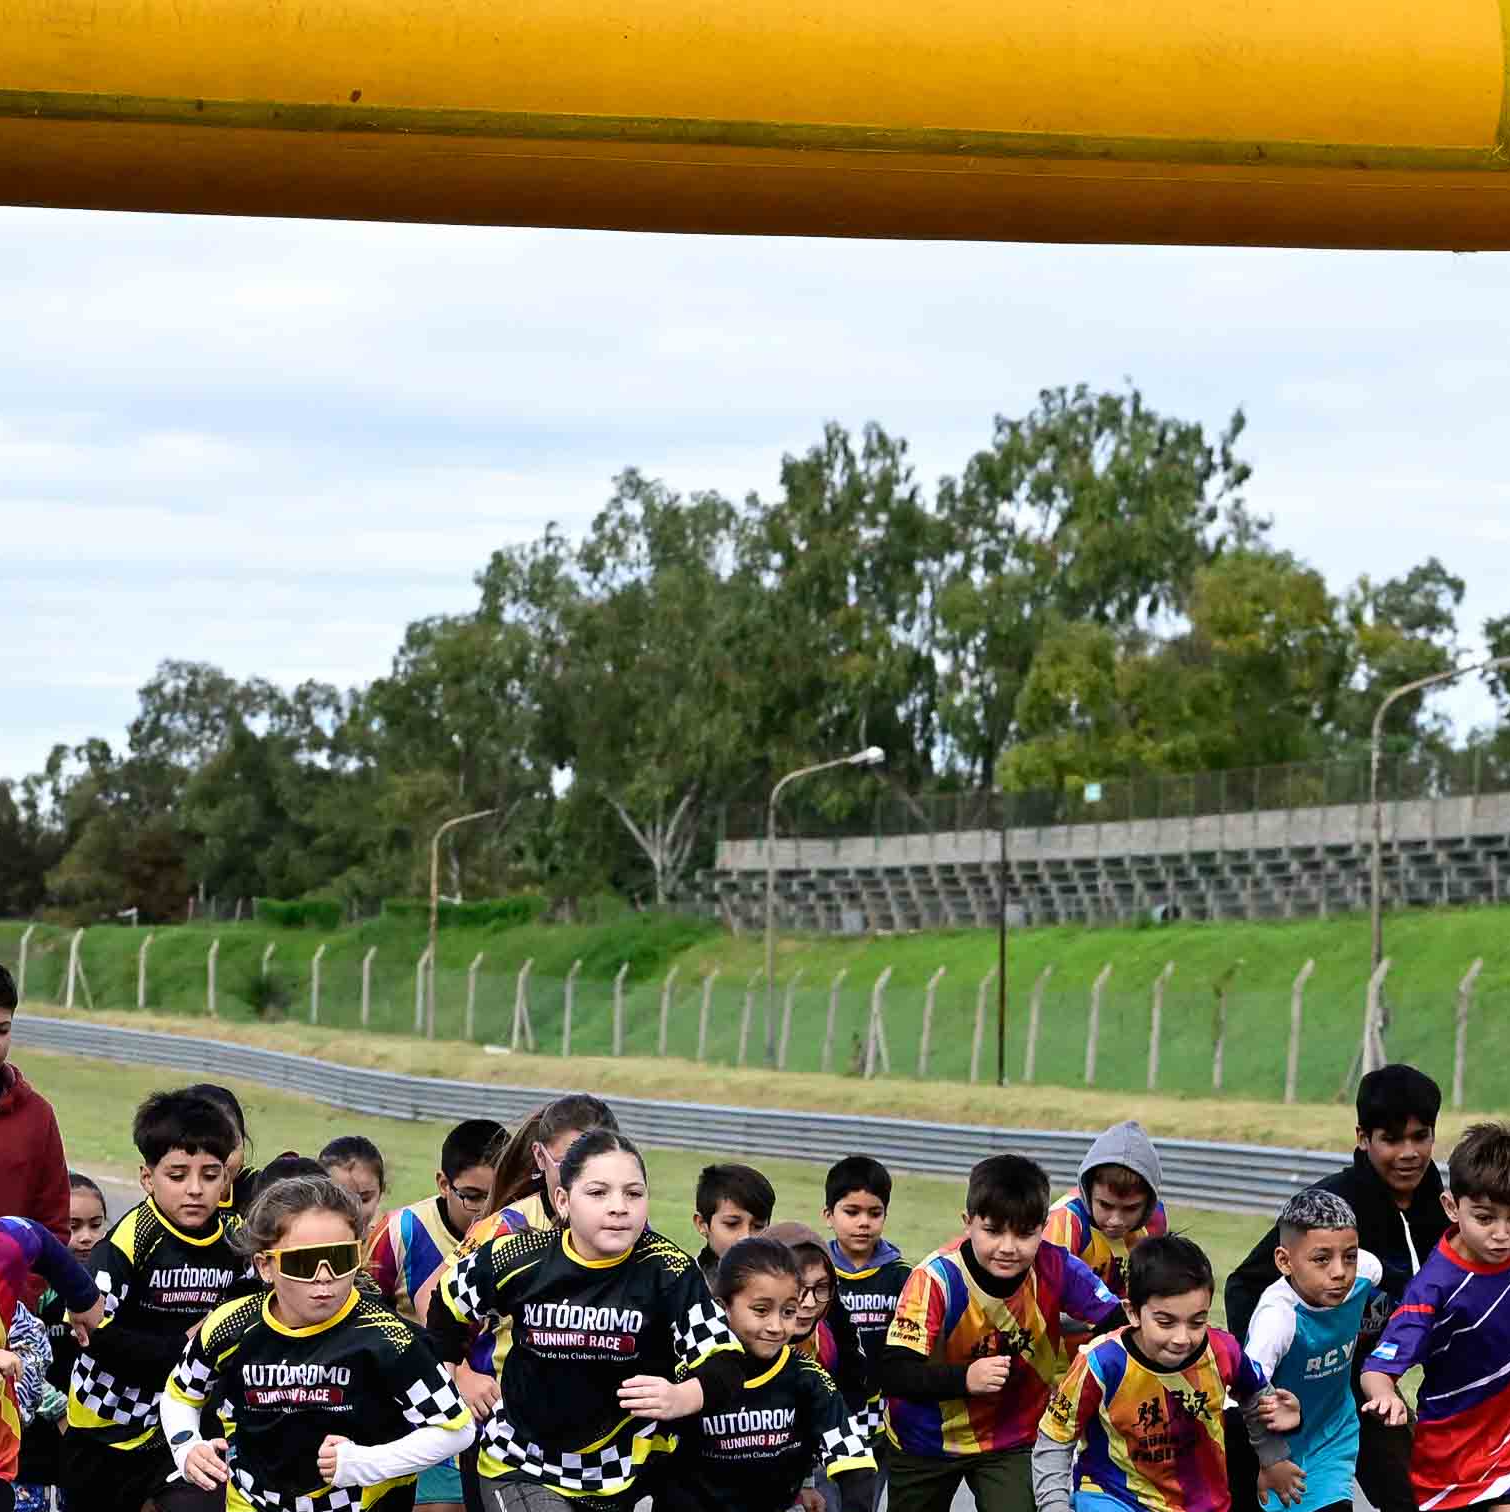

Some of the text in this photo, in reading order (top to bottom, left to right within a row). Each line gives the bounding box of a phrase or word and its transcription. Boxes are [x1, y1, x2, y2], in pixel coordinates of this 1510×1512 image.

[162, 1291, 199, 1303] RUNNING
[532, 1332, 620, 1351] RUNNING RACE
[558, 1352, 570, 1360] los
[571, 1352, 596, 1361] Clubes
[300, 1389, 330, 1402] RACE
[702, 1406, 796, 1436] AUTÓDROM
[720, 1434, 765, 1451] RUNNING
